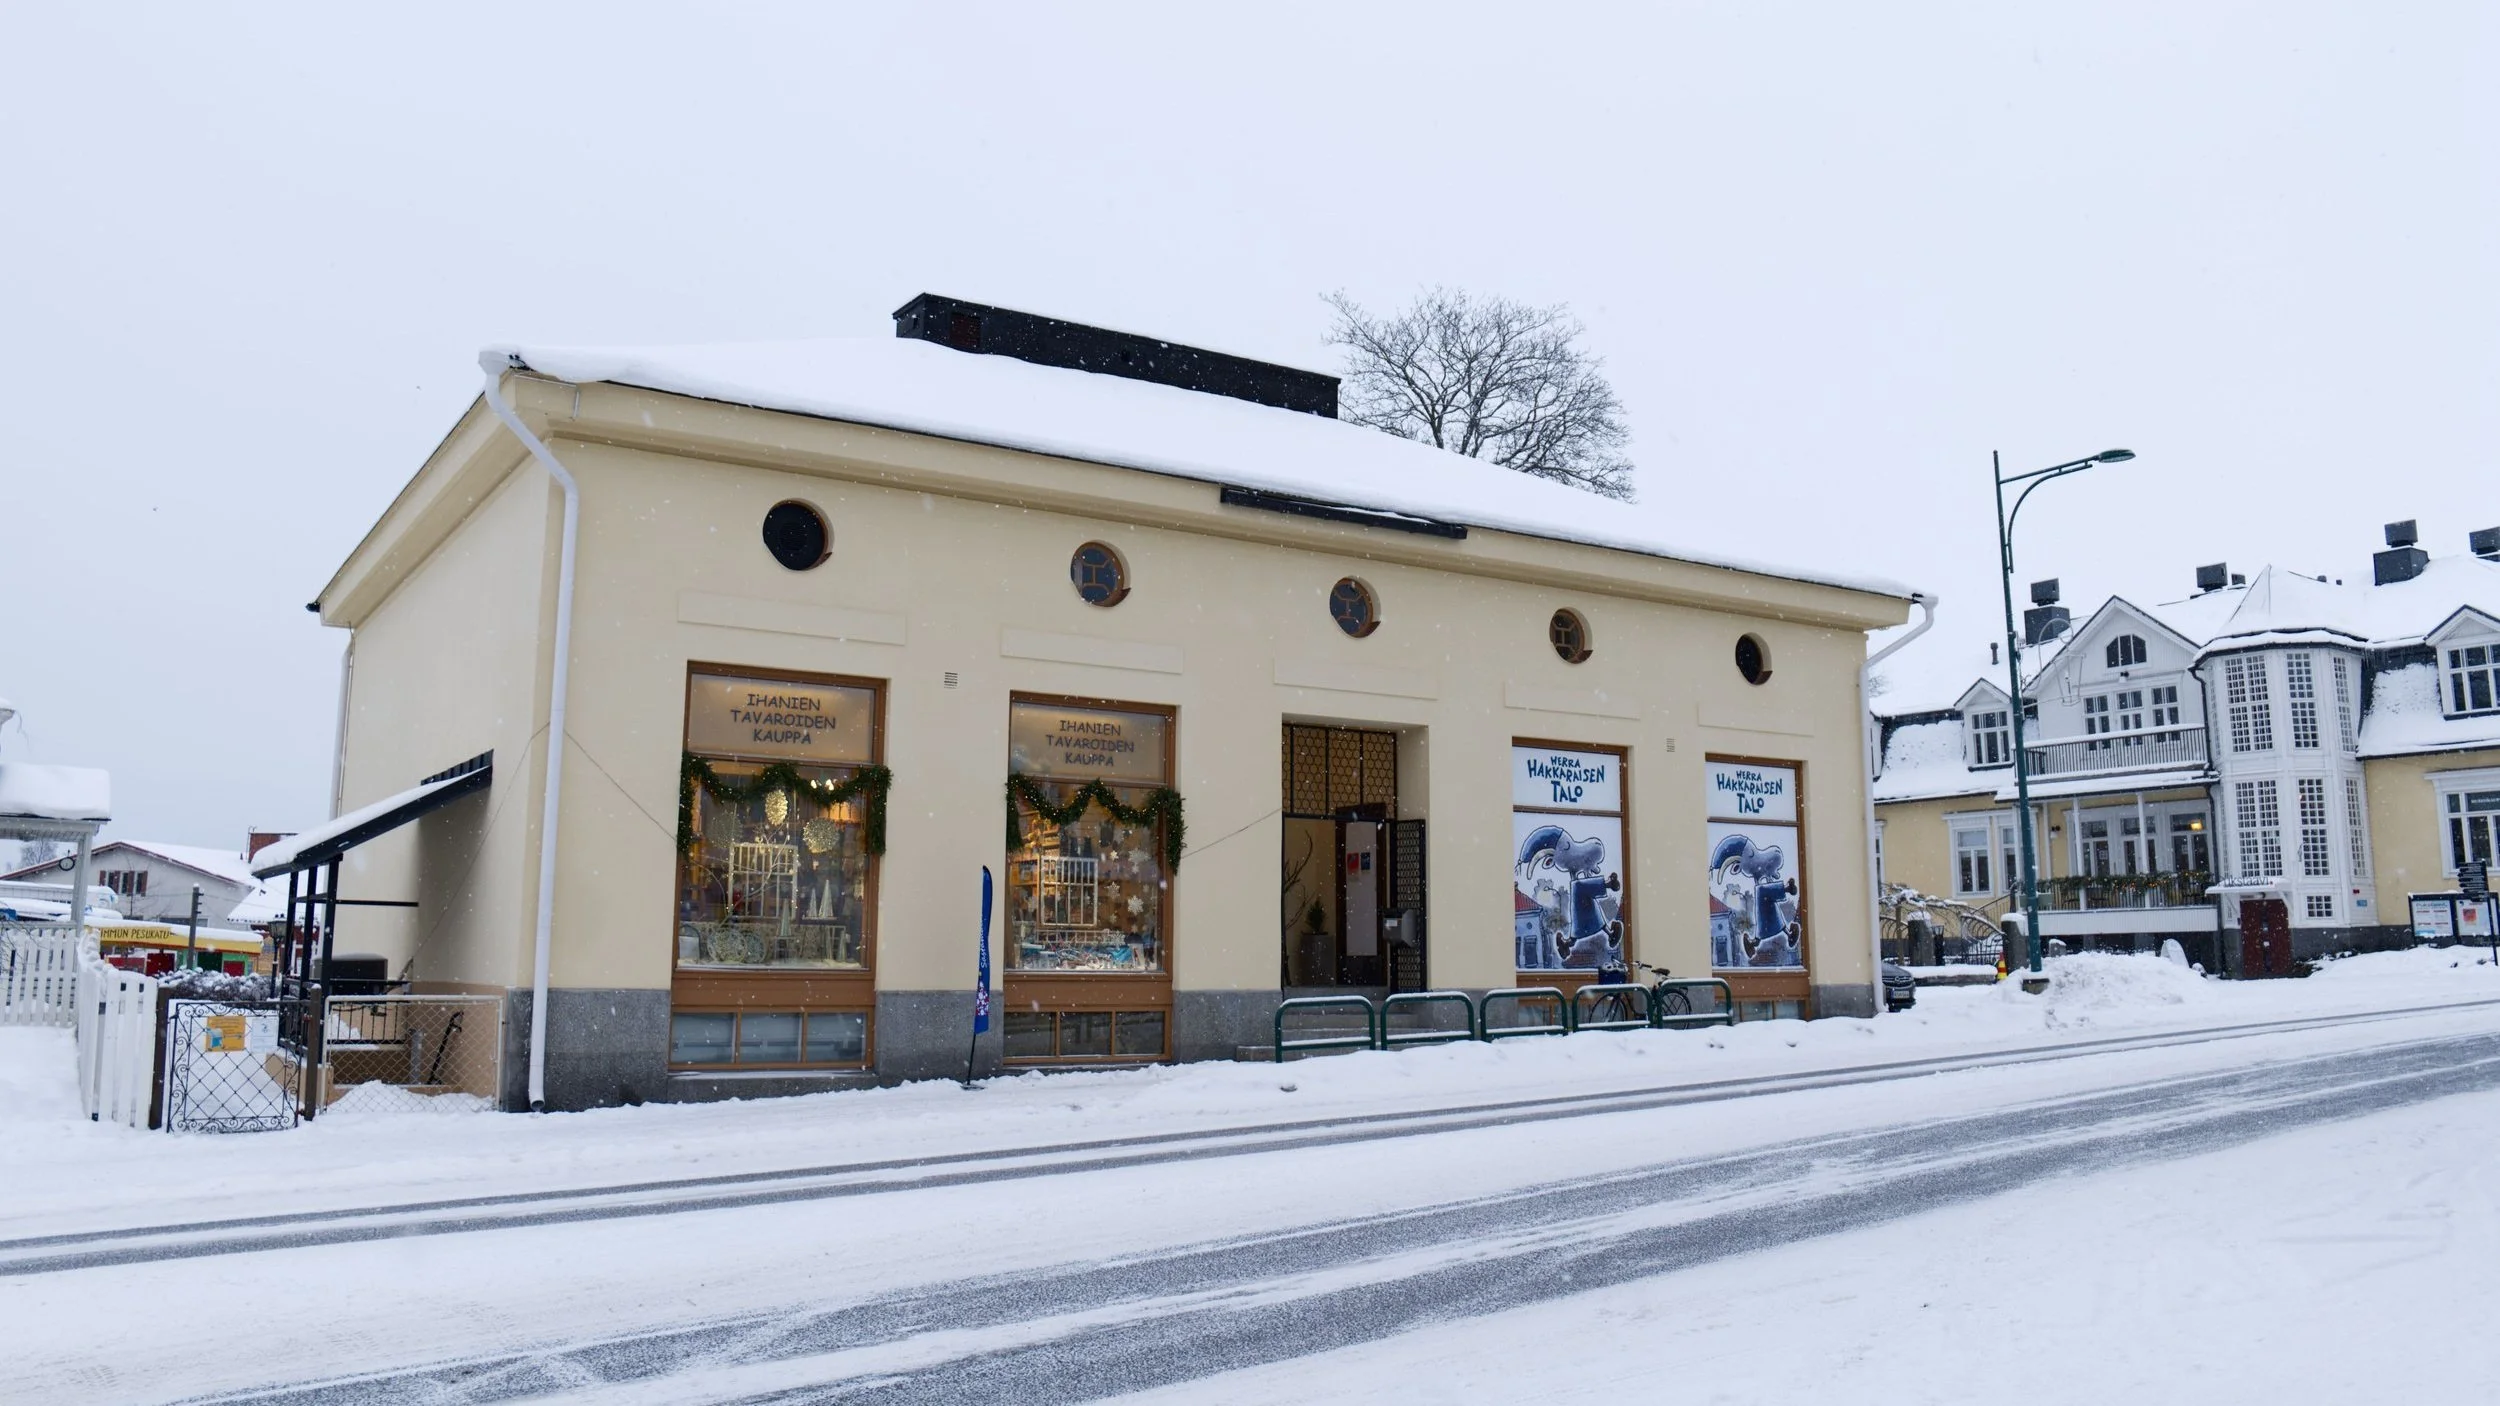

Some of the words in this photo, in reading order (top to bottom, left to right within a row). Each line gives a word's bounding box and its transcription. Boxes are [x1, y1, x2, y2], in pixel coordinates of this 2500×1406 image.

[747, 693, 821, 711] IHANIEN
[730, 709, 836, 729] TAVAROIDEN
[1059, 720, 1121, 736] IHANIEN
[753, 728, 812, 745] KAUPPA
[1045, 734, 1135, 753] TAVAROIDEN
[1065, 751, 1114, 767] KAUPPA
[1550, 756, 1581, 768] HERRA
[1527, 758, 1605, 783] HAKKARAISEN
[1736, 770, 1762, 782] HERRA
[1550, 780, 1583, 803] TALO
[1716, 773, 1783, 795] HAKKARAISEN
[1736, 793, 1765, 814] TALO
